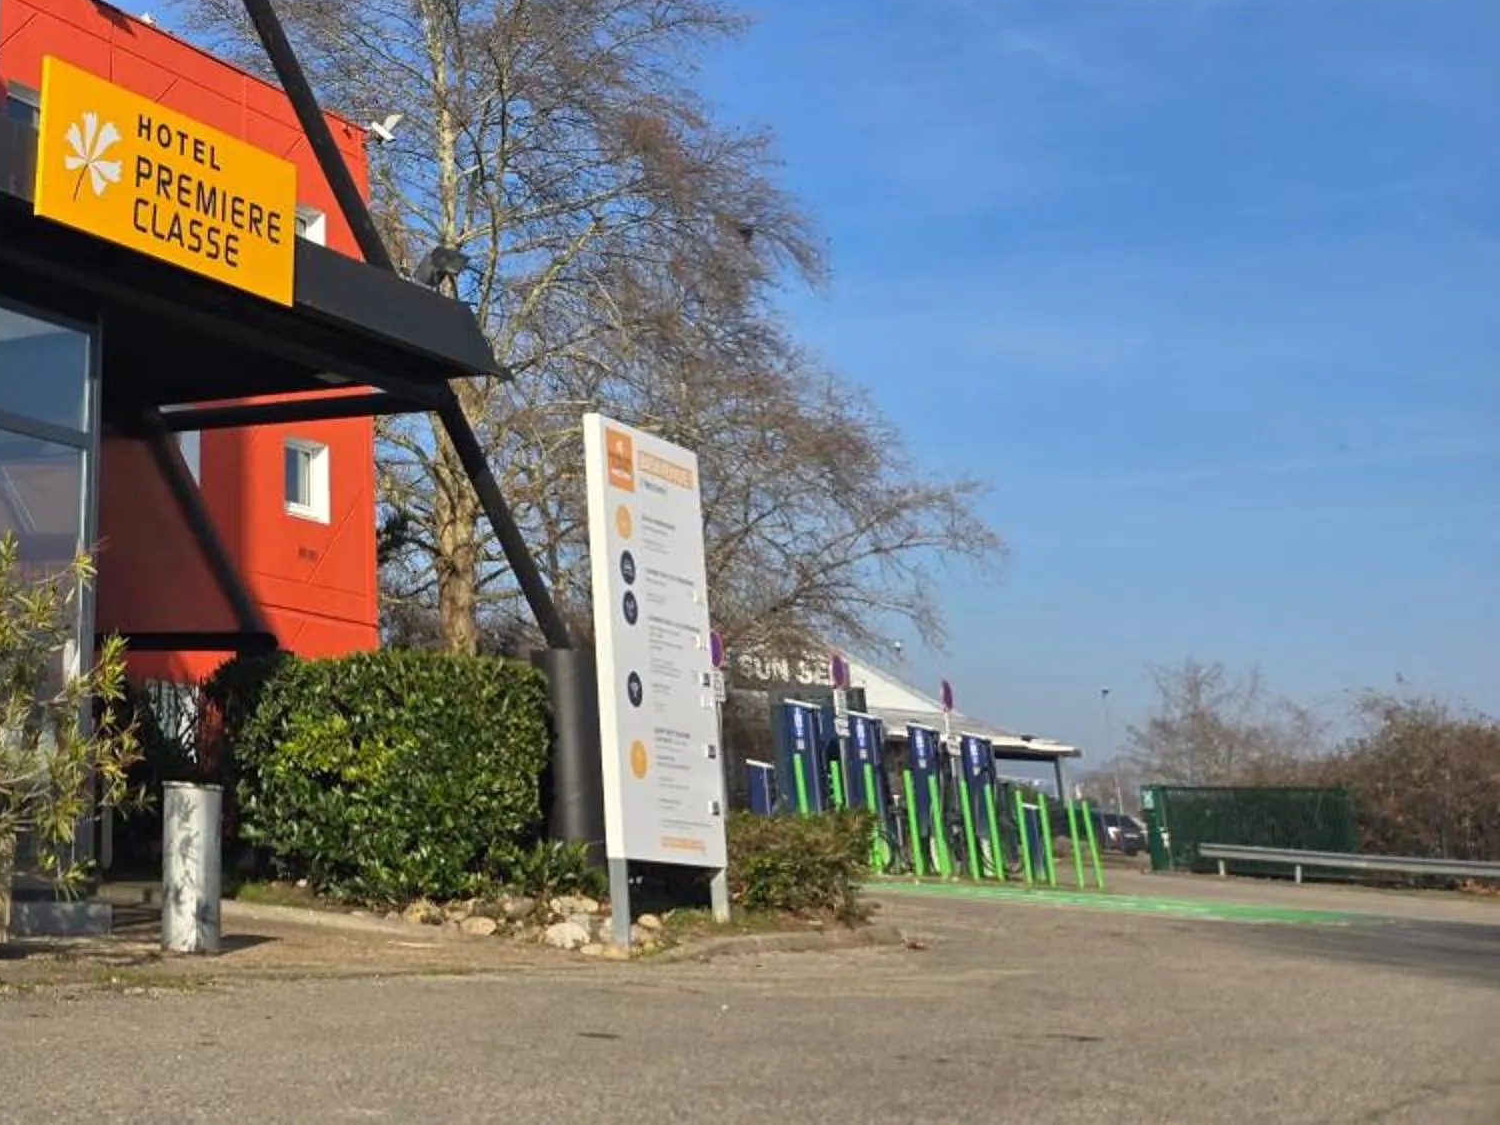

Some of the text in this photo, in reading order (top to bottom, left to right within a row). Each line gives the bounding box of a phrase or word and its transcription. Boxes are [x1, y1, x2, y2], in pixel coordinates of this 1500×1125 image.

[137, 114, 220, 171] HOTEL
[133, 198, 239, 268] CLASSE
[135, 156, 281, 244] PREMIERE
